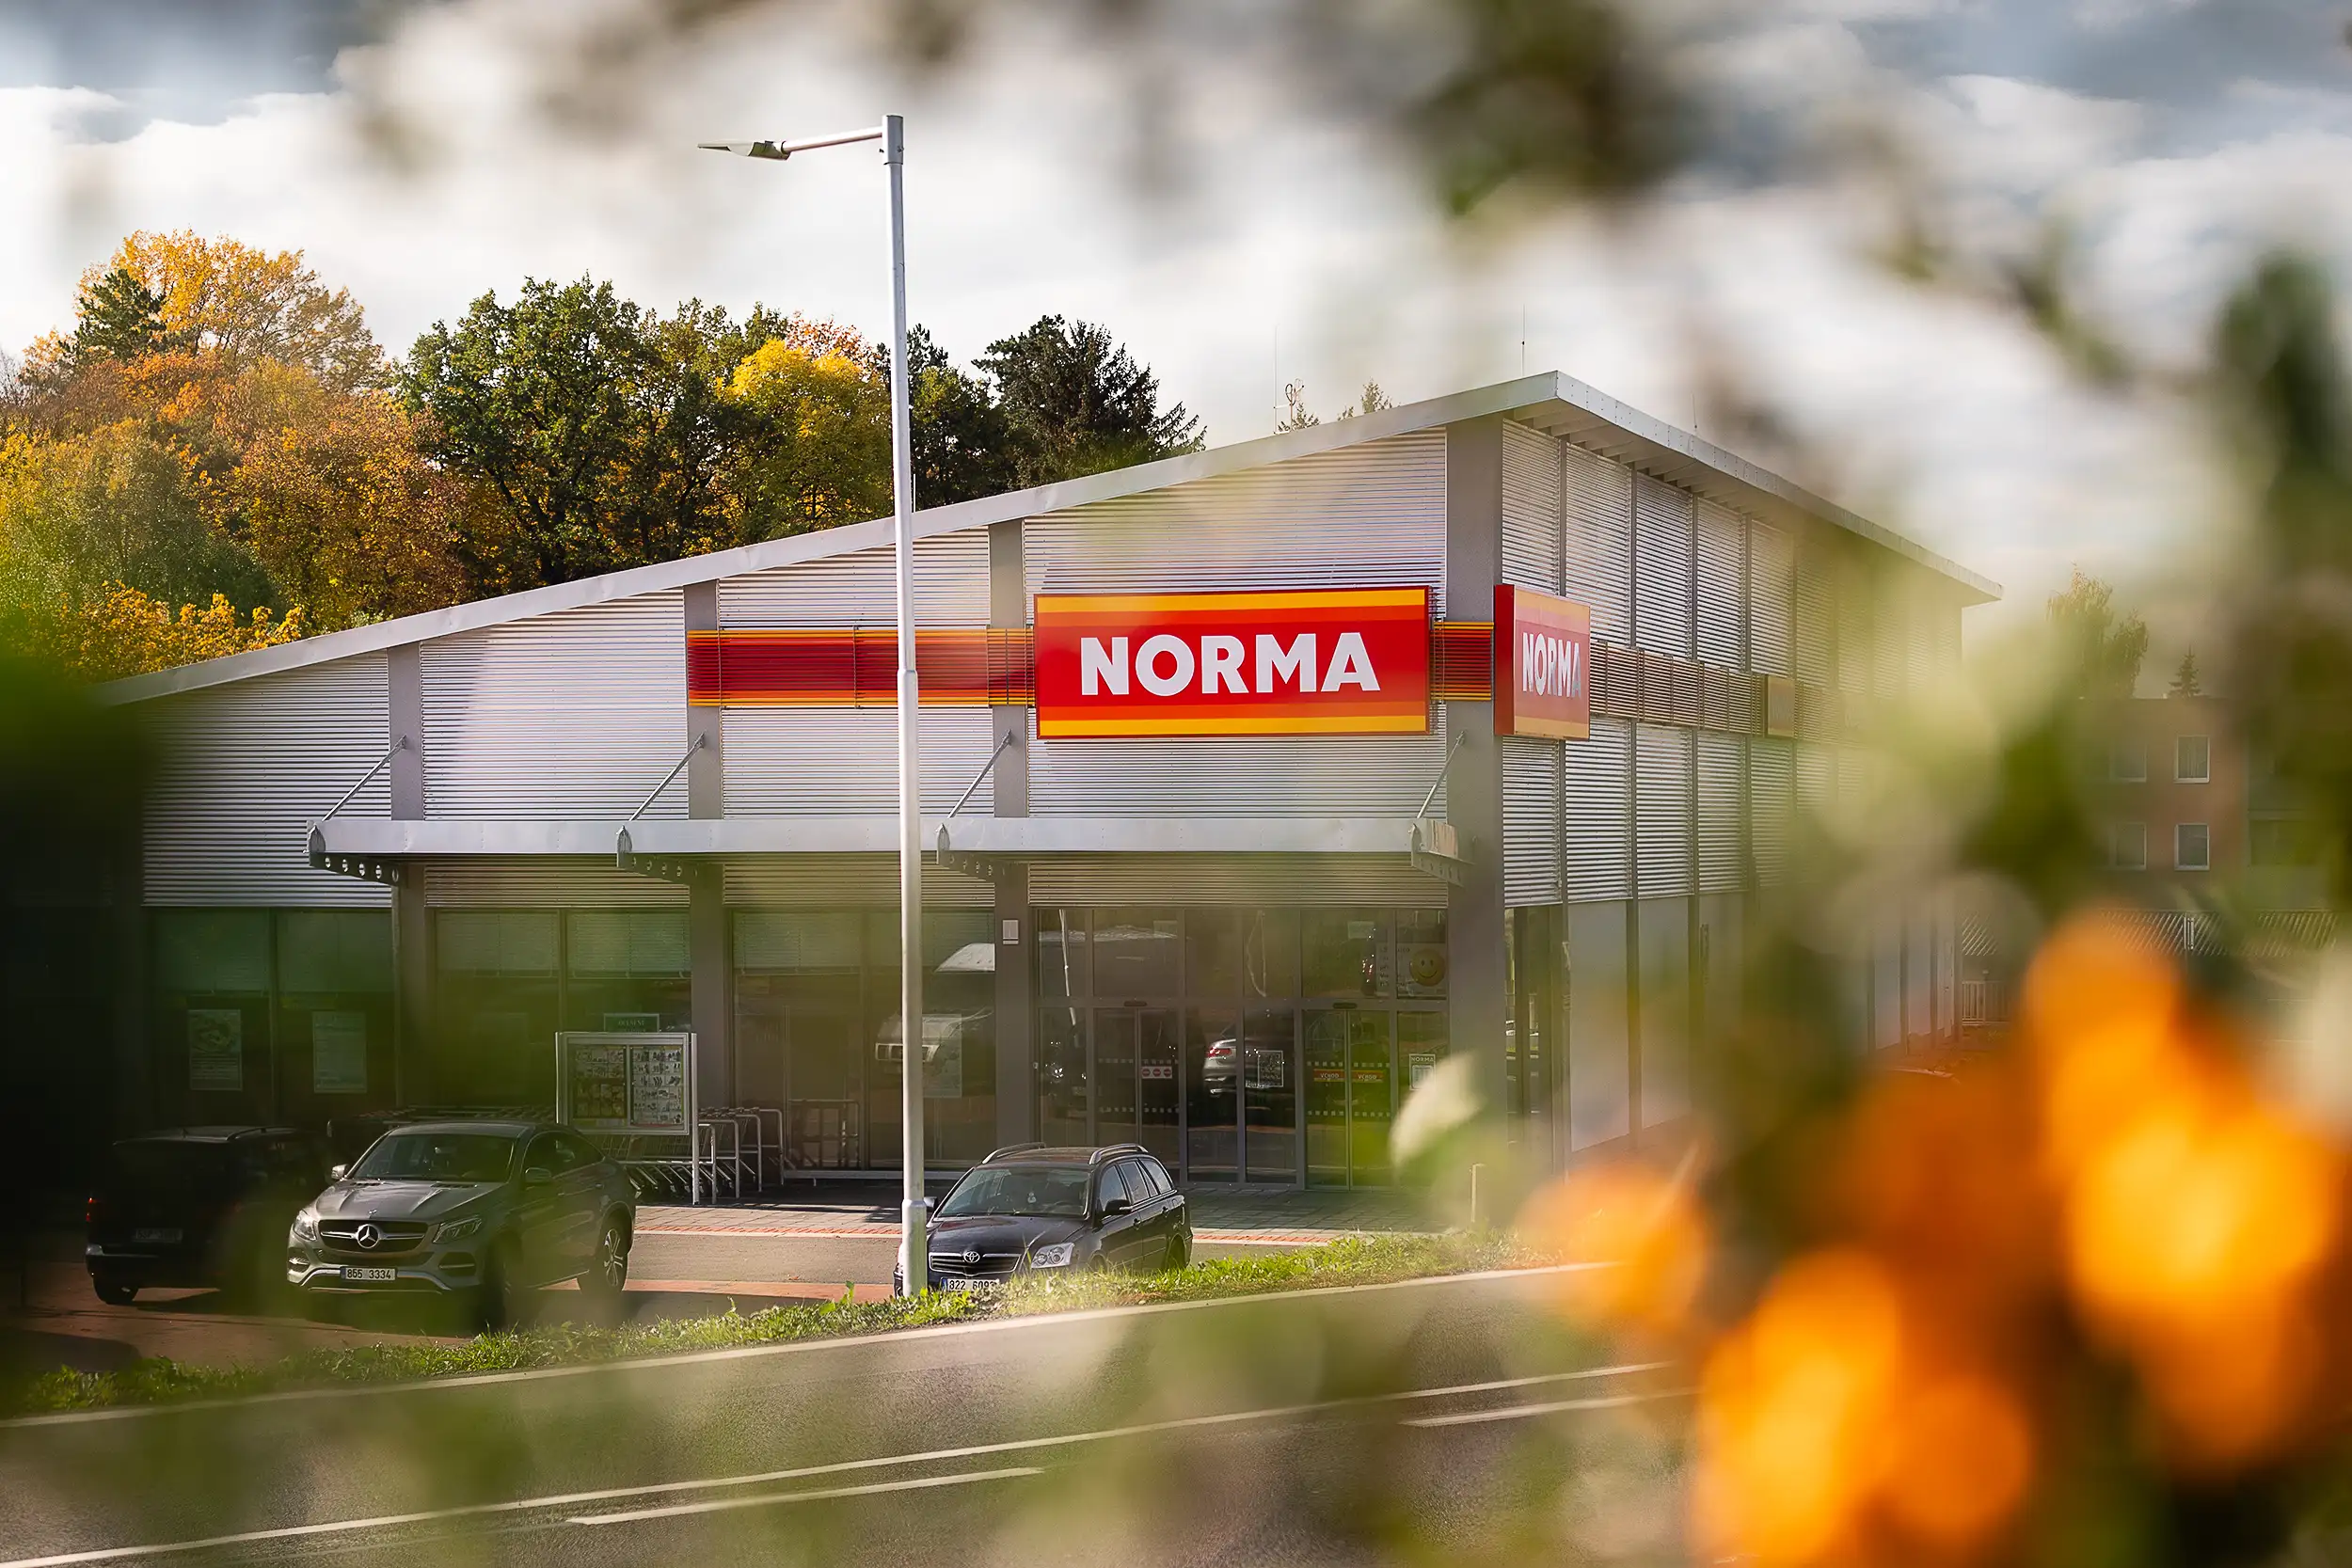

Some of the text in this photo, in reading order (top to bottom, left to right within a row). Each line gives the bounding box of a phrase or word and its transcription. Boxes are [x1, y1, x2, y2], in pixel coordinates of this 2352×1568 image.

[1081, 632, 1381, 696] NORMA
[1522, 631, 1581, 698] NORMA
[368, 1270, 391, 1279] 3334
